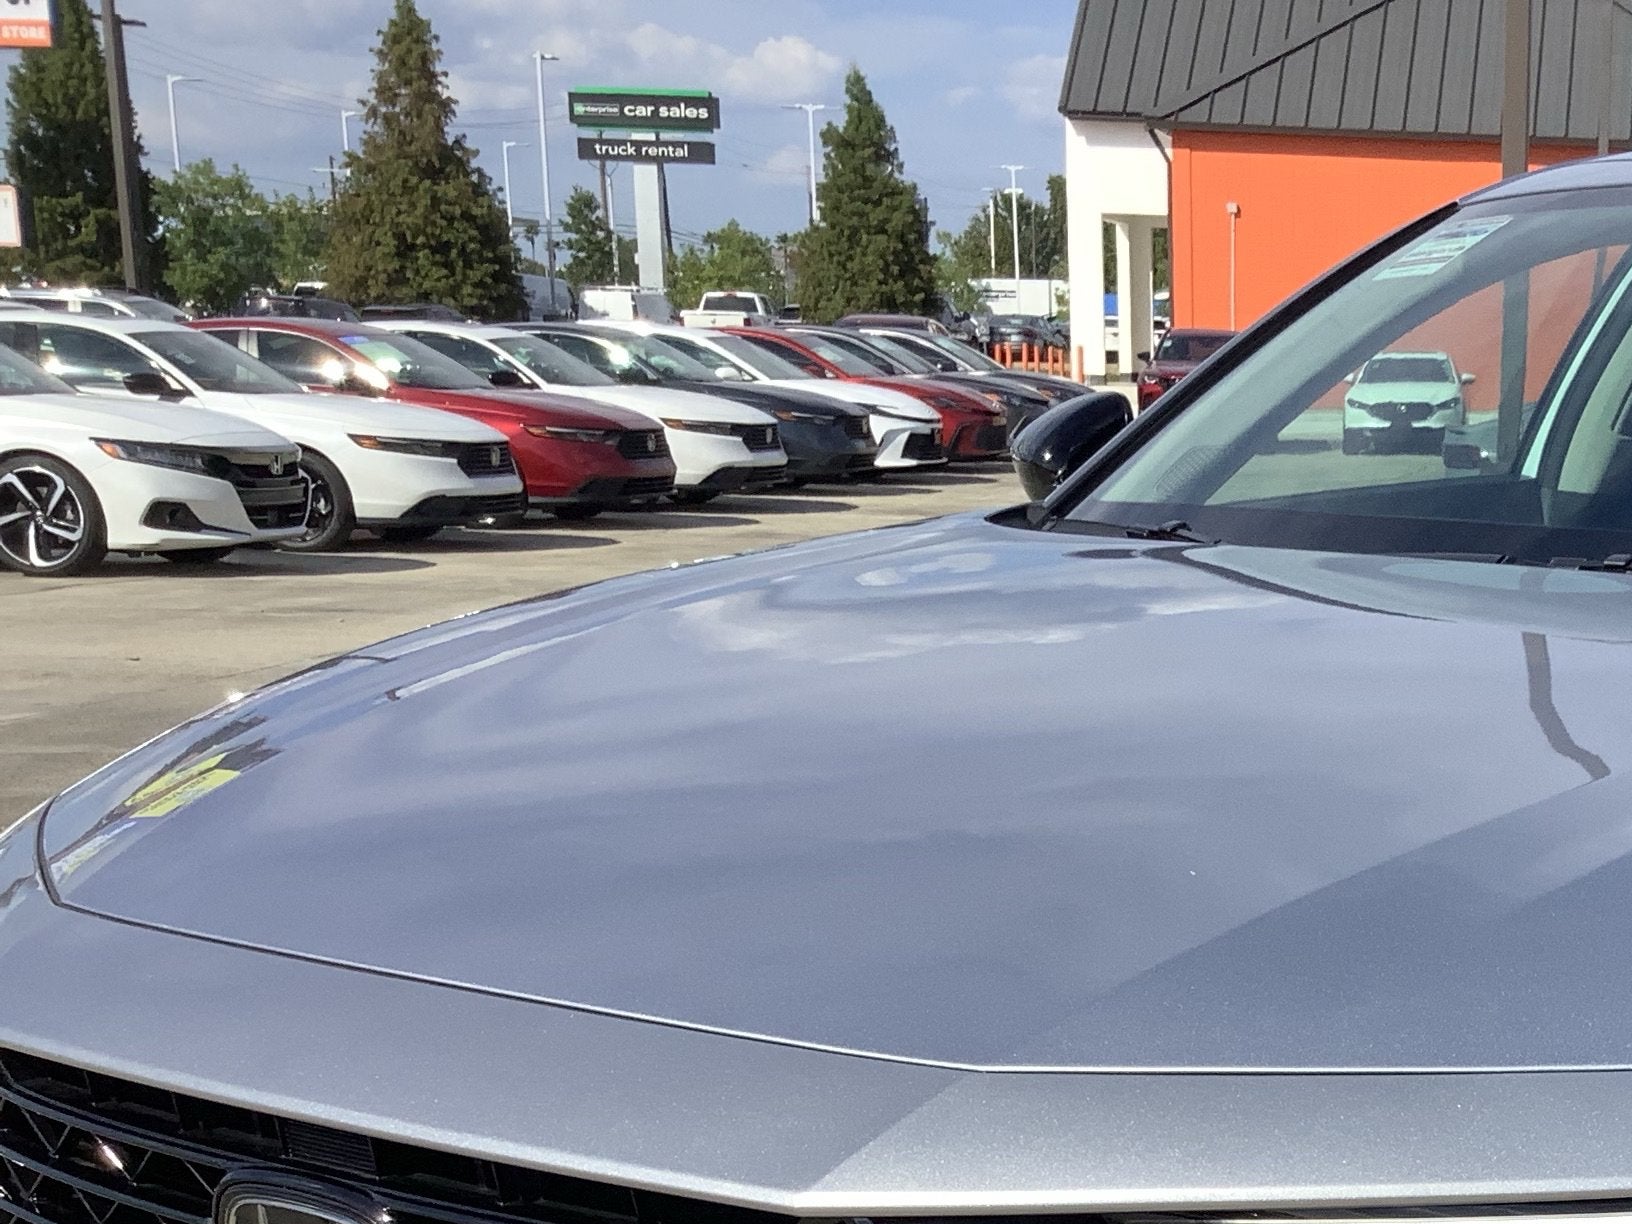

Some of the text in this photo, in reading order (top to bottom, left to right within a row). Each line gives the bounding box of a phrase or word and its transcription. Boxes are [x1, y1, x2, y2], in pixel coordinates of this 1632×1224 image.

[623, 104, 655, 117] car
[659, 102, 709, 119] sales
[594, 142, 689, 158] truck rental
